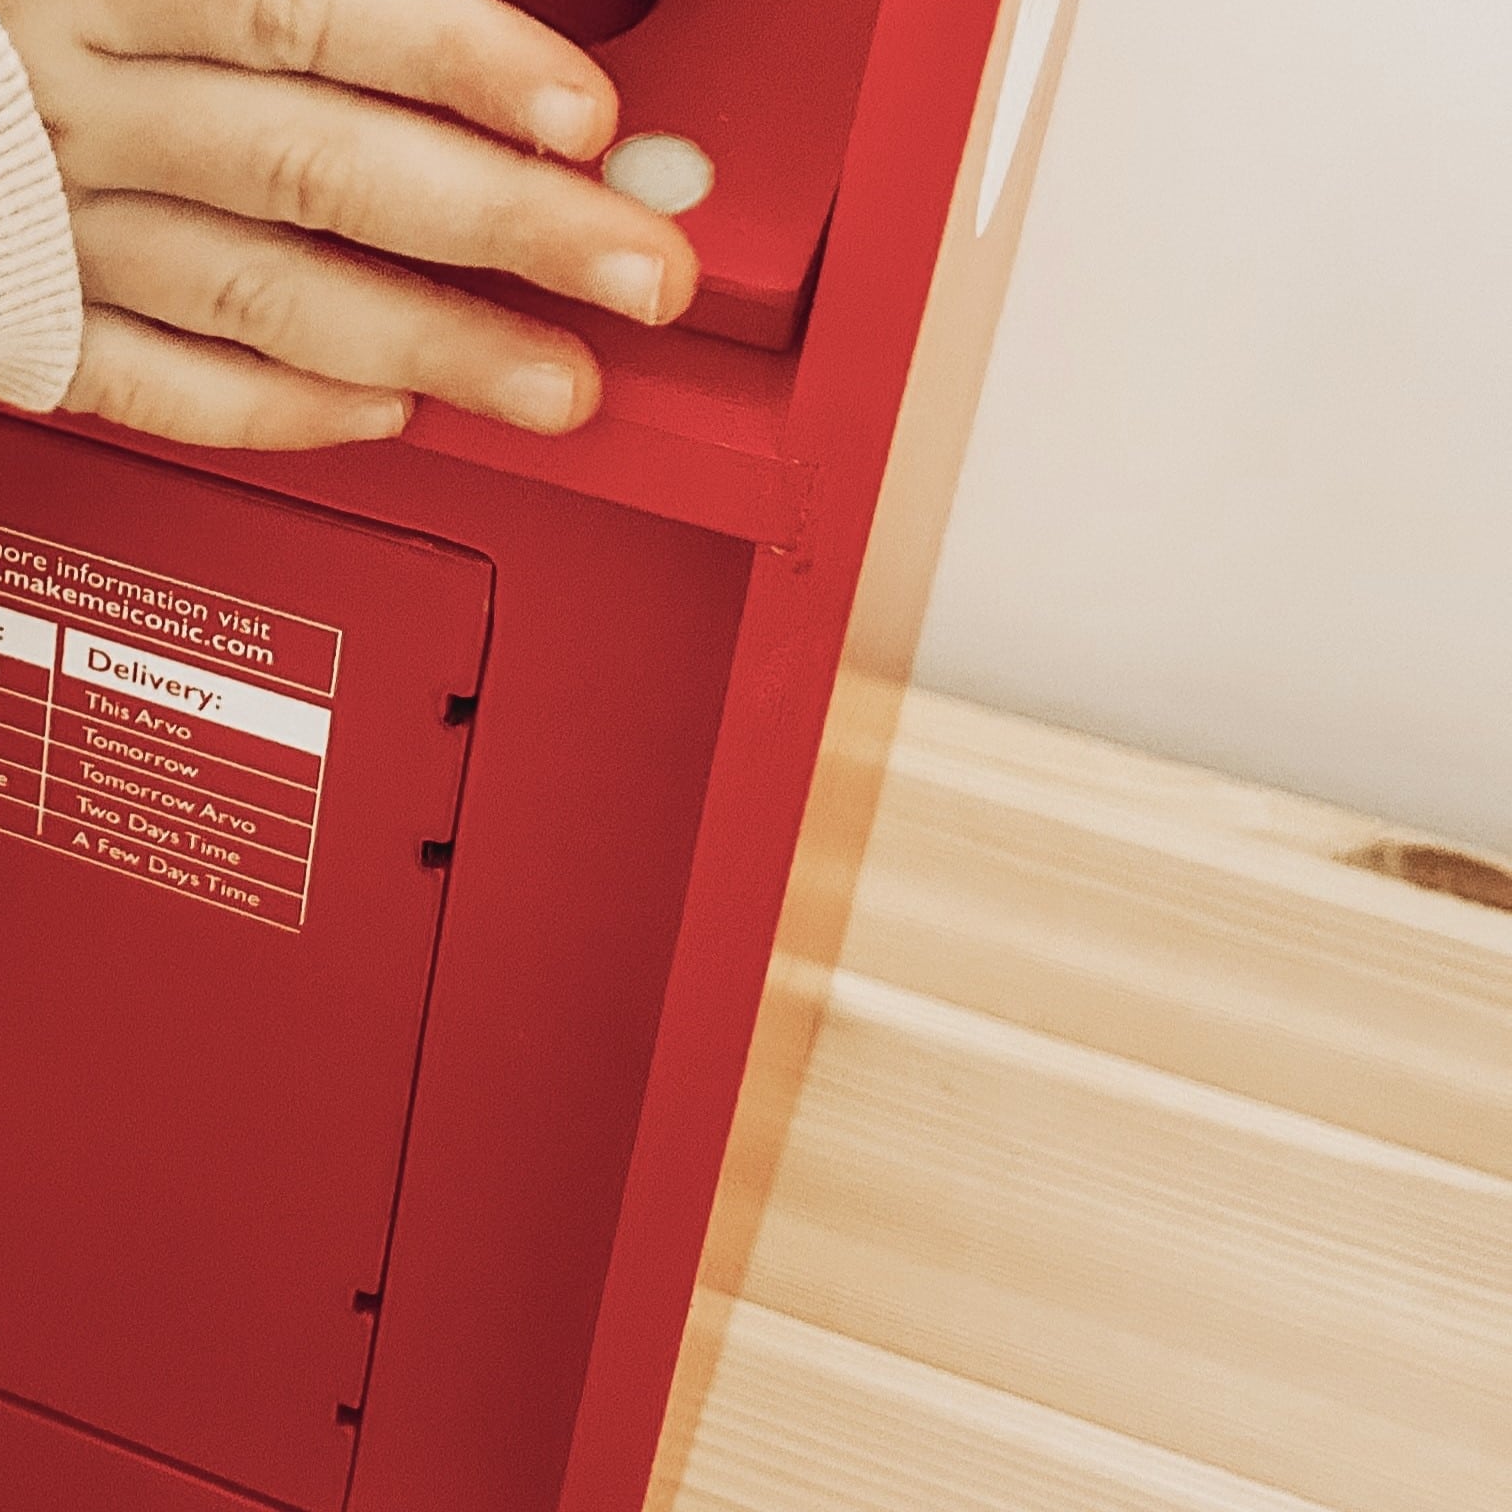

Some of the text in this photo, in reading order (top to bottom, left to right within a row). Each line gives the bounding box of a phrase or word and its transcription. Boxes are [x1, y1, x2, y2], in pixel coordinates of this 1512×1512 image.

[56, 556, 209, 622] information
[218, 608, 271, 641] visit
[85, 690, 193, 740] This Arvo
[87, 647, 223, 713] Delivery:
[82, 725, 200, 779] Tomorrow
[76, 794, 241, 866] Two Days Time
[79, 760, 257, 835] Tomorrow Arvo
[72, 831, 261, 908] A Few Days Time
